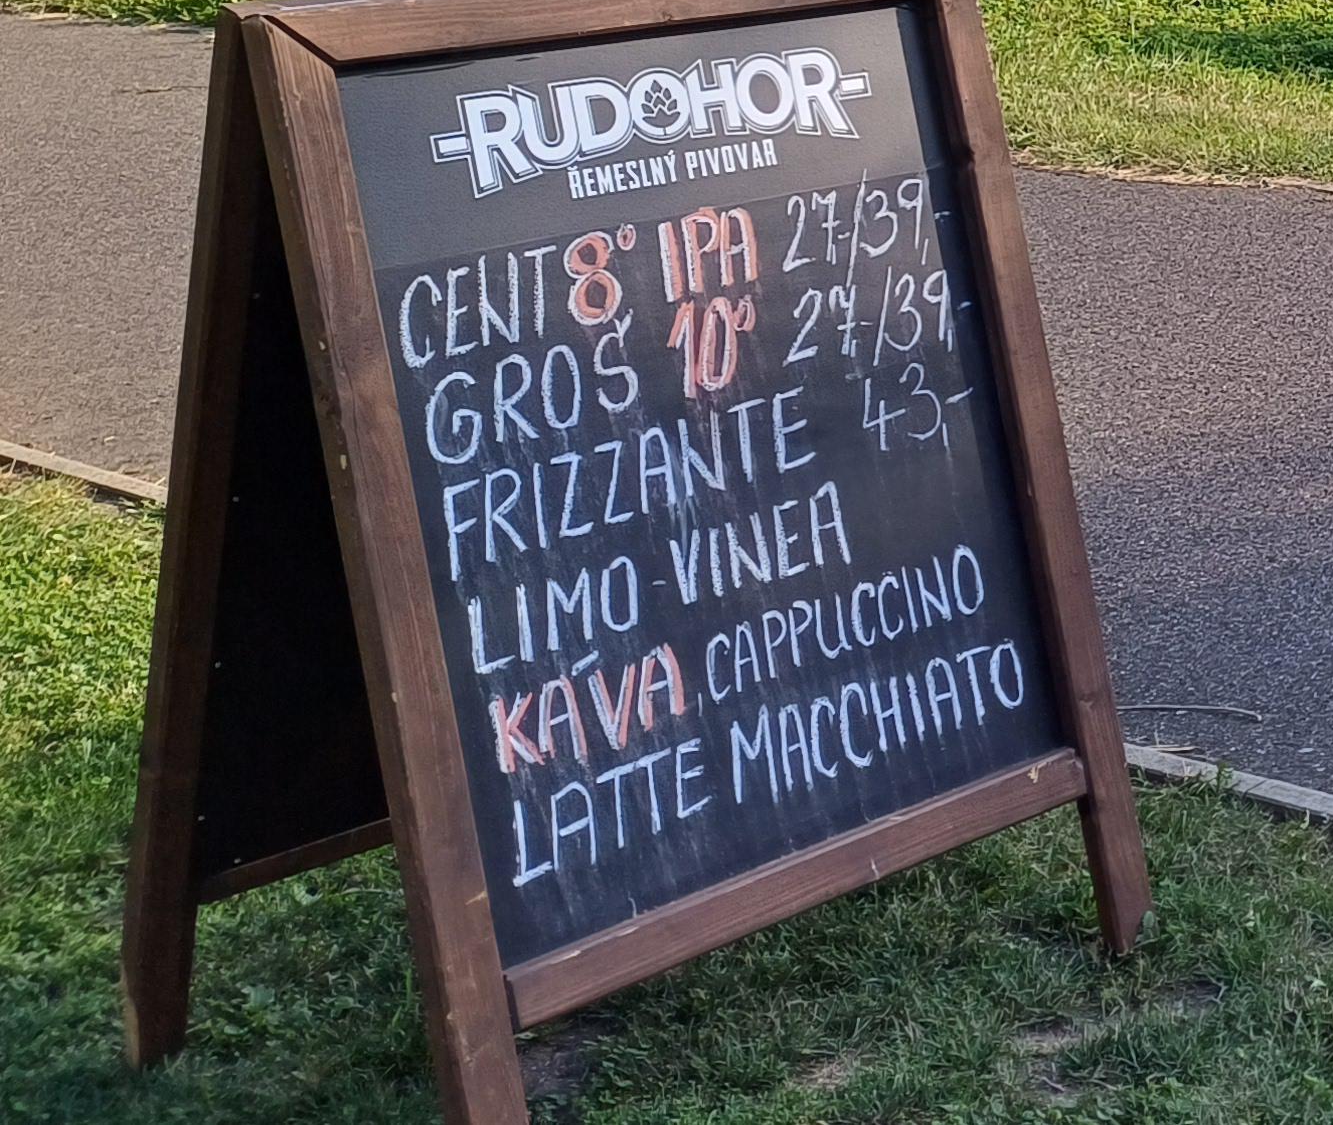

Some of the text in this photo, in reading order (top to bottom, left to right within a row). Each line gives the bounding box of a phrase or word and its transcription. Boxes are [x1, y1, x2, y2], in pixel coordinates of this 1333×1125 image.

[567, 137, 779, 200] ŘEMESLNÝ PIVOVAR
[400, 244, 557, 370] CENT
[658, 206, 759, 303] IPA
[443, 386, 817, 582] FRIZZANTE
[706, 544, 985, 704] CAPPUCCINO
[513, 638, 1025, 887] LATTE MACCHIATO
